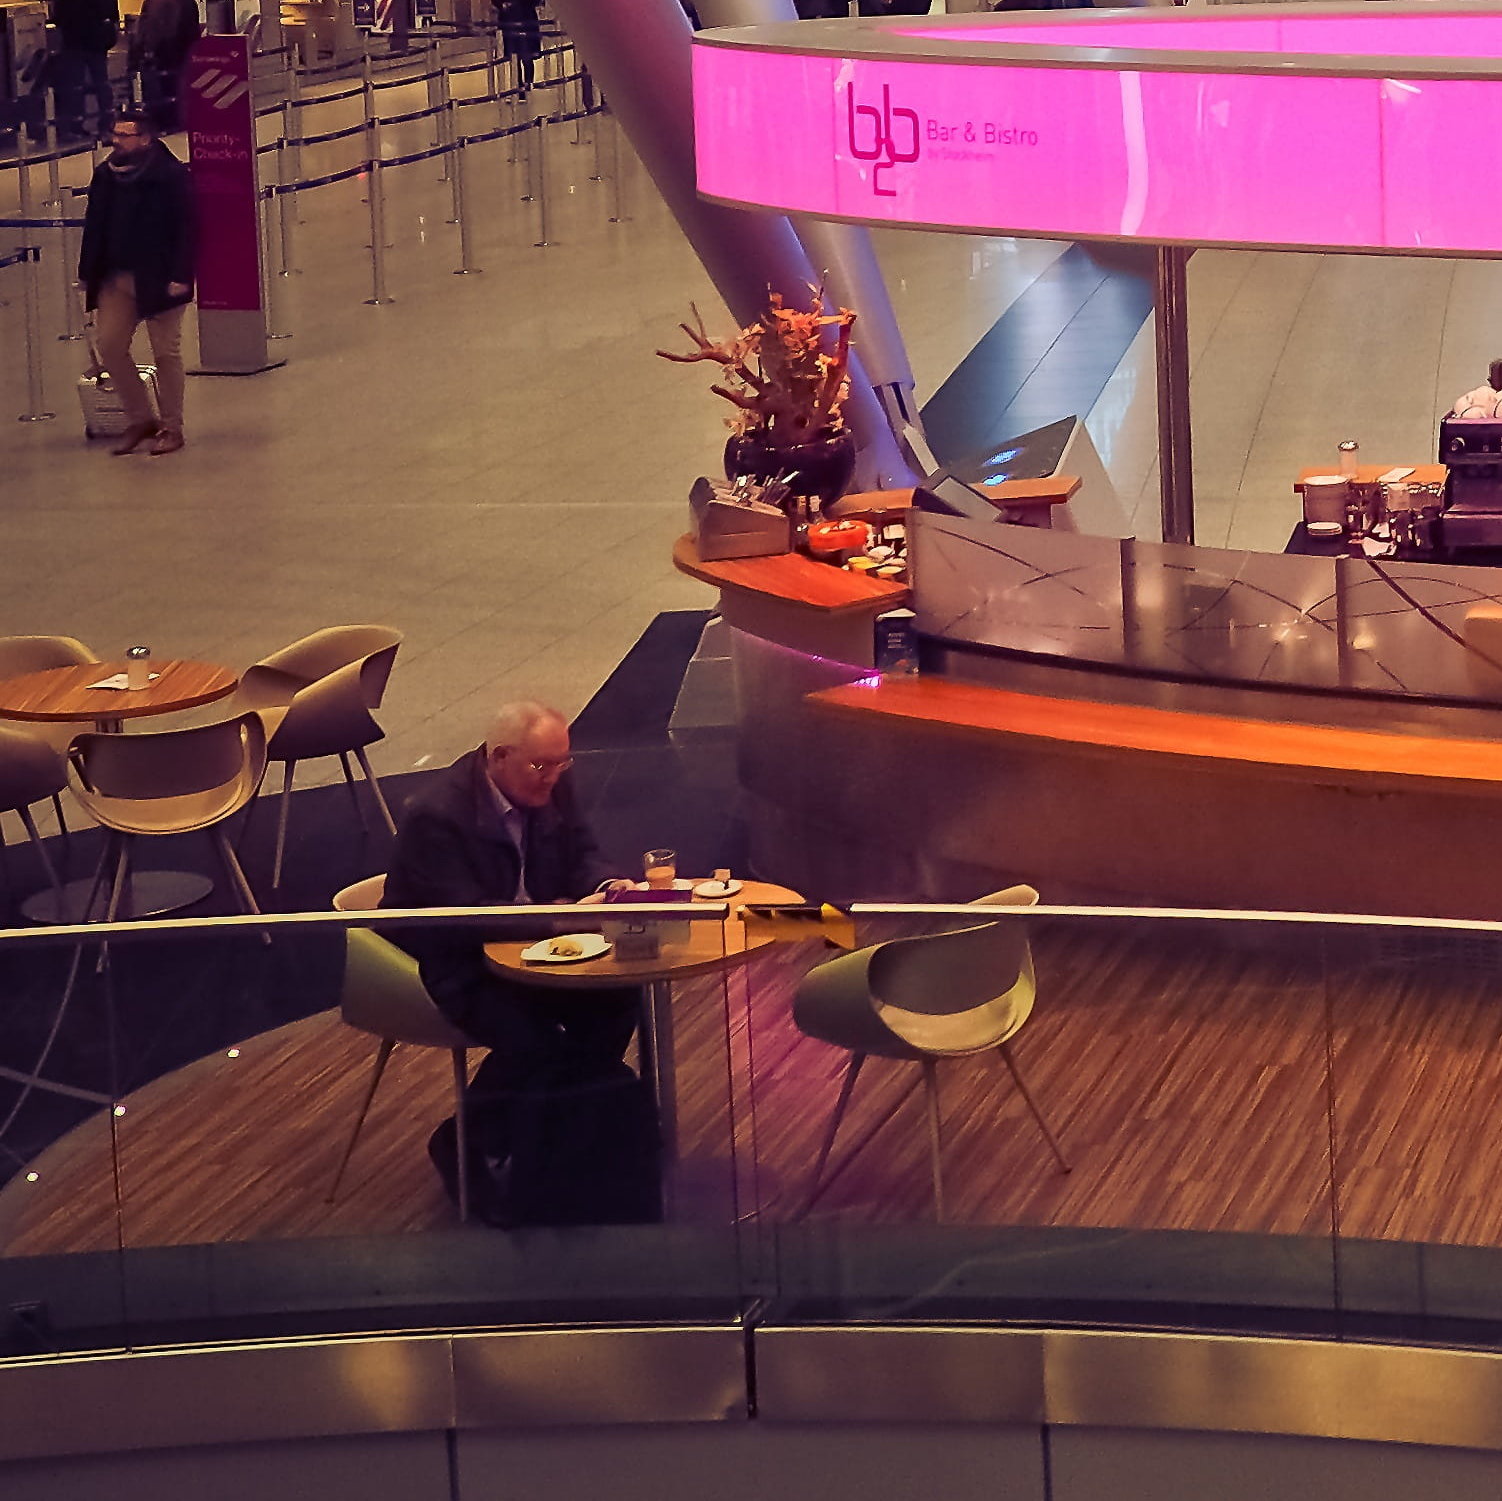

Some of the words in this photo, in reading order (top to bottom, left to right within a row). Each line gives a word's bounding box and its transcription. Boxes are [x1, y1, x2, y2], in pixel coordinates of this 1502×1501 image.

[927, 119, 959, 141] Bar
[964, 121, 976, 143] &
[984, 122, 1038, 146] Bistro
[193, 147, 248, 161] Check-in
